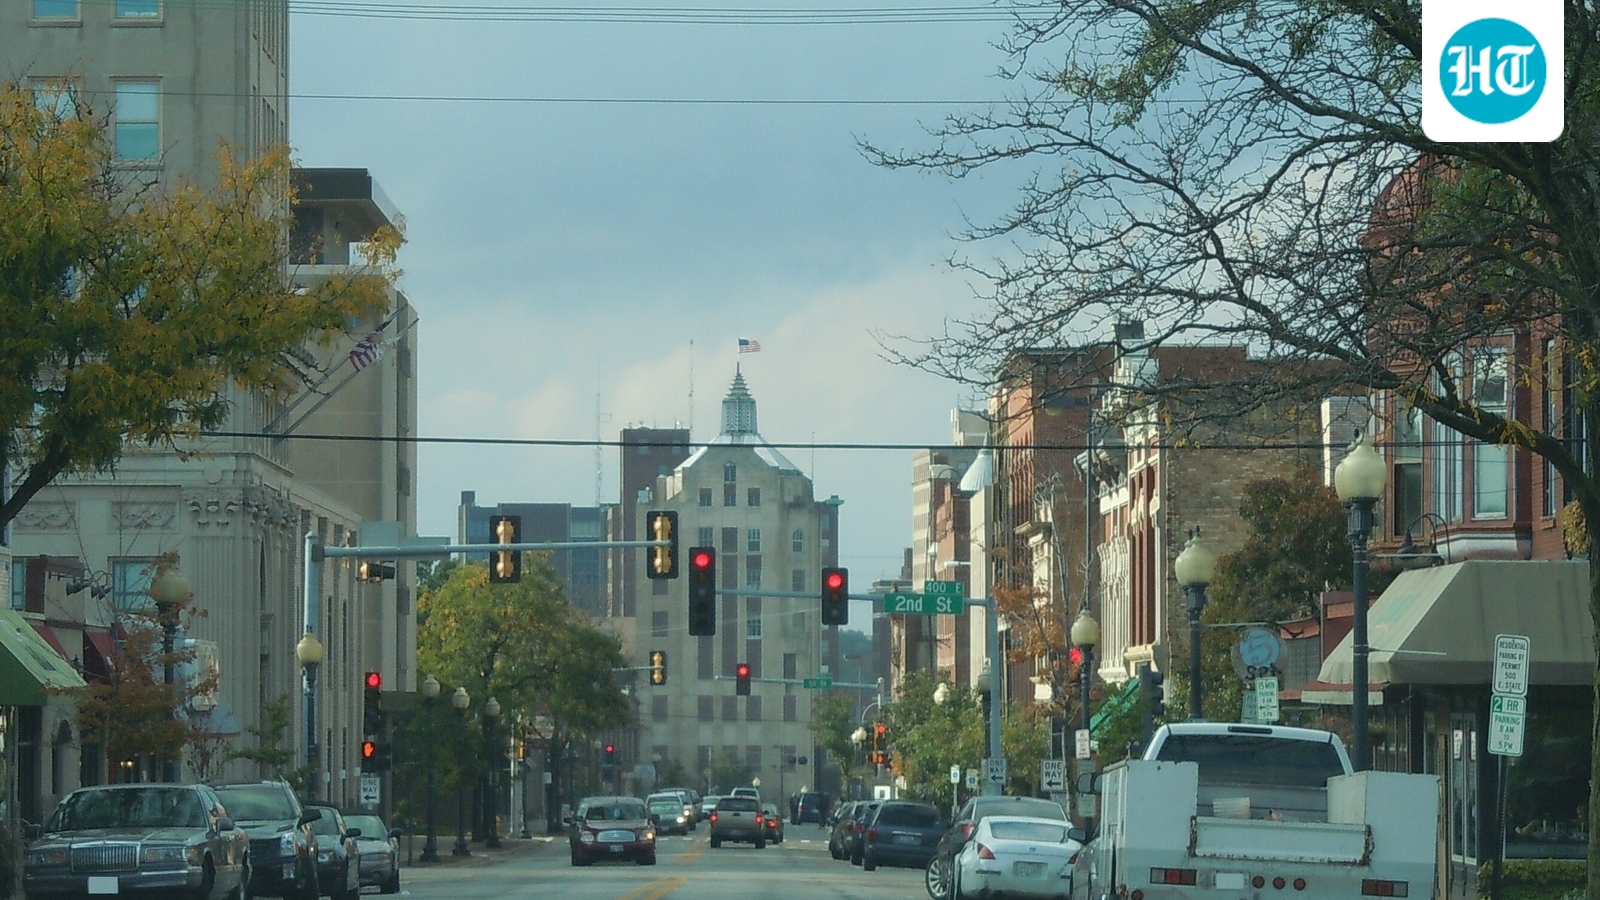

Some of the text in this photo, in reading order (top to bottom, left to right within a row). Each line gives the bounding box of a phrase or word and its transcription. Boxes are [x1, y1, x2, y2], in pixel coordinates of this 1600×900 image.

[926, 582, 961, 593] 400 E
[895, 596, 952, 612] 2nd St
[1499, 641, 1526, 651] RESIDENTIAL
[1499, 651, 1525, 662] PARKING BY
[1501, 661, 1521, 670] PERMIT
[1245, 663, 1282, 680] SPA
[1504, 671, 1516, 680] 500
[1258, 681, 1265, 690] 15
[1505, 681, 1521, 690] STATE
[1493, 696, 1519, 712] 2 HR
[1494, 714, 1520, 726] PARKING
[1499, 724, 1514, 733] 8 AM
[1498, 741, 1513, 750] 5 PM
[989, 759, 1004, 767] ONE
[1044, 761, 1062, 770] ONE
[1044, 771, 1062, 779] WAY
